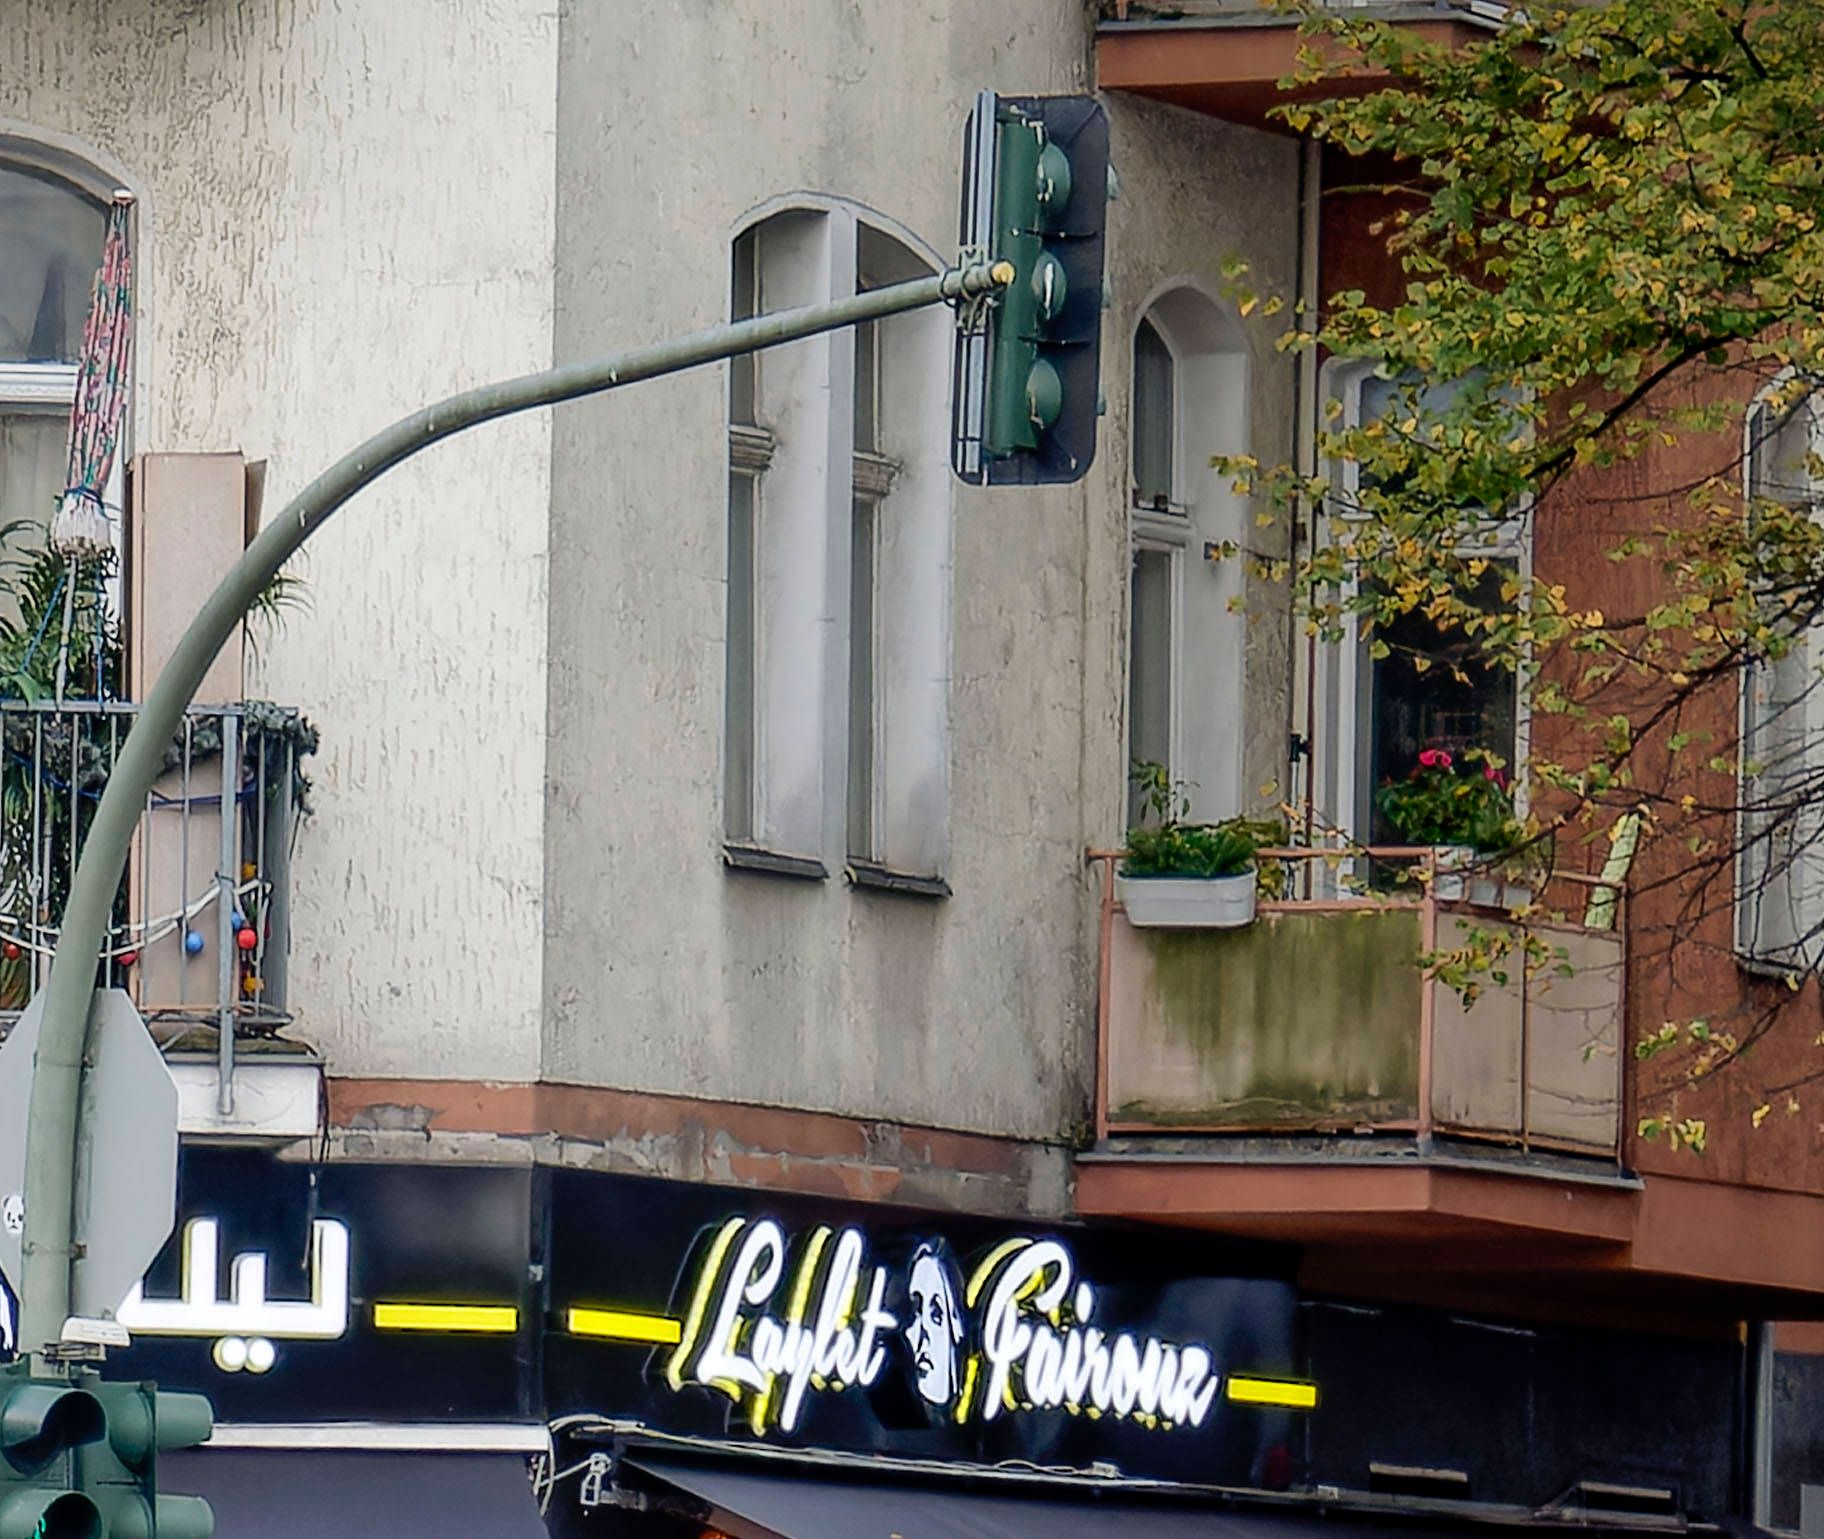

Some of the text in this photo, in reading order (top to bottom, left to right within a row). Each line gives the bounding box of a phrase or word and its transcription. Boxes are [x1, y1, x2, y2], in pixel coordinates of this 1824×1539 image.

[115, 1215, 349, 1374] ليل
[688, 1217, 1219, 1432] Laylet Fairouz
